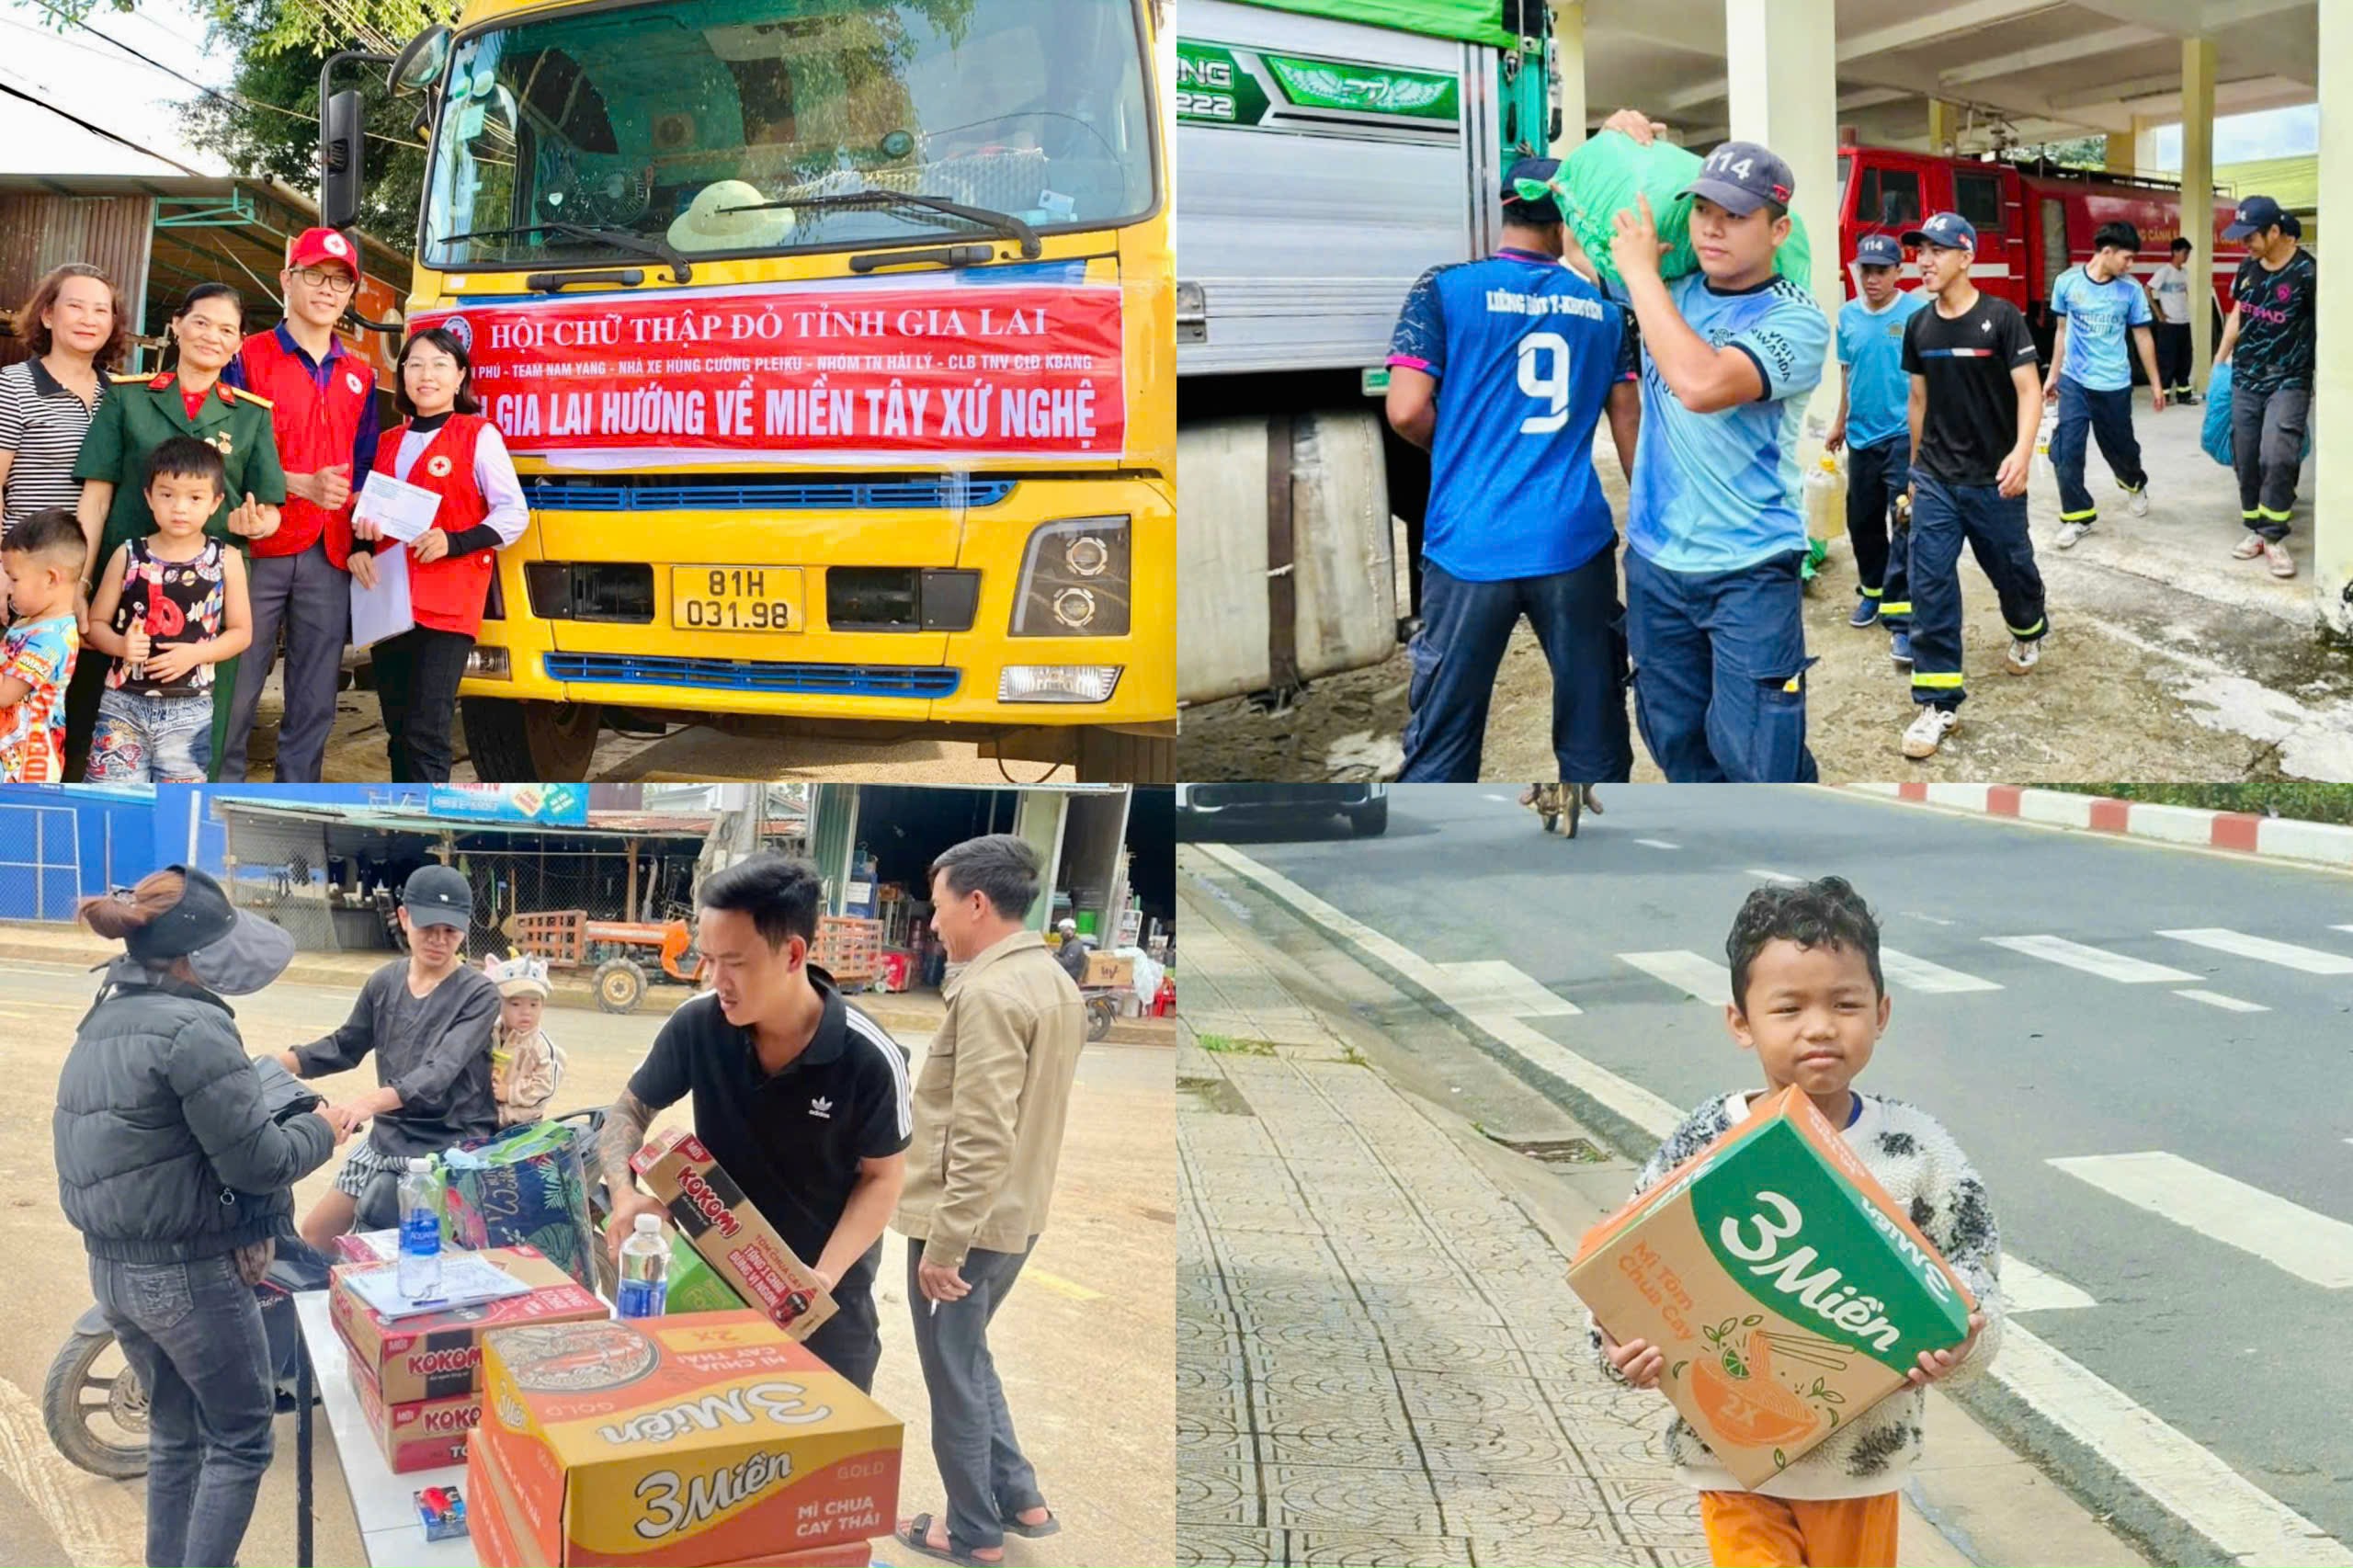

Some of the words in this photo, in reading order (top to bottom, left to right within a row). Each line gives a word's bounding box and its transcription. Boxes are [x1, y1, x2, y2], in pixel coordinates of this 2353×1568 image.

[1177, 57, 1231, 85] NG
[1706, 152, 1754, 180] 114
[1864, 240, 1884, 252] 114
[490, 316, 544, 353] HỘI
[553, 312, 623, 346] CHỮ
[631, 308, 722, 349] THẬP
[731, 304, 783, 340] ĐỎ
[793, 301, 885, 337] TỈNH
[897, 308, 971, 337] GIA
[979, 307, 1050, 336] LAI
[1769, 332, 1795, 362] VISIT
[479, 363, 501, 379] PHÚ
[512, 364, 542, 378] TEAM
[547, 362, 572, 376] NAM
[576, 361, 606, 375] YANG
[619, 357, 643, 375] NHÀ
[647, 359, 662, 374] XE
[666, 356, 701, 374] HÙNG
[705, 355, 750, 372] CƯỜNG
[755, 356, 802, 372] PLEIKU
[817, 352, 859, 370] NHÓM
[865, 355, 882, 369] TN
[949, 354, 976, 369] CLB
[981, 354, 1010, 369] TNV
[1045, 354, 1092, 369] KBANG
[1518, 332, 1570, 435] 9
[496, 393, 540, 437] GIA
[549, 392, 593, 435] LAI
[602, 380, 705, 436] HƯỚNG
[716, 375, 756, 437] VỀ
[766, 372, 853, 437] MIỀN
[865, 378, 929, 437] TÂY
[940, 378, 992, 437] XỨ
[1000, 379, 1097, 449] NGHỆ
[709, 570, 764, 597] 81H
[688, 600, 789, 629] 031.98
[677, 1165, 743, 1239] KOKOMI
[407, 1346, 483, 1375] KOKOM
[423, 1405, 482, 1434] KOKO
[837, 1461, 884, 1480] GOLD
[798, 1500, 819, 1520] MÌ
[824, 1495, 874, 1516] CHUA
[796, 1519, 833, 1537] CAY
[837, 1510, 881, 1530] THÁI
